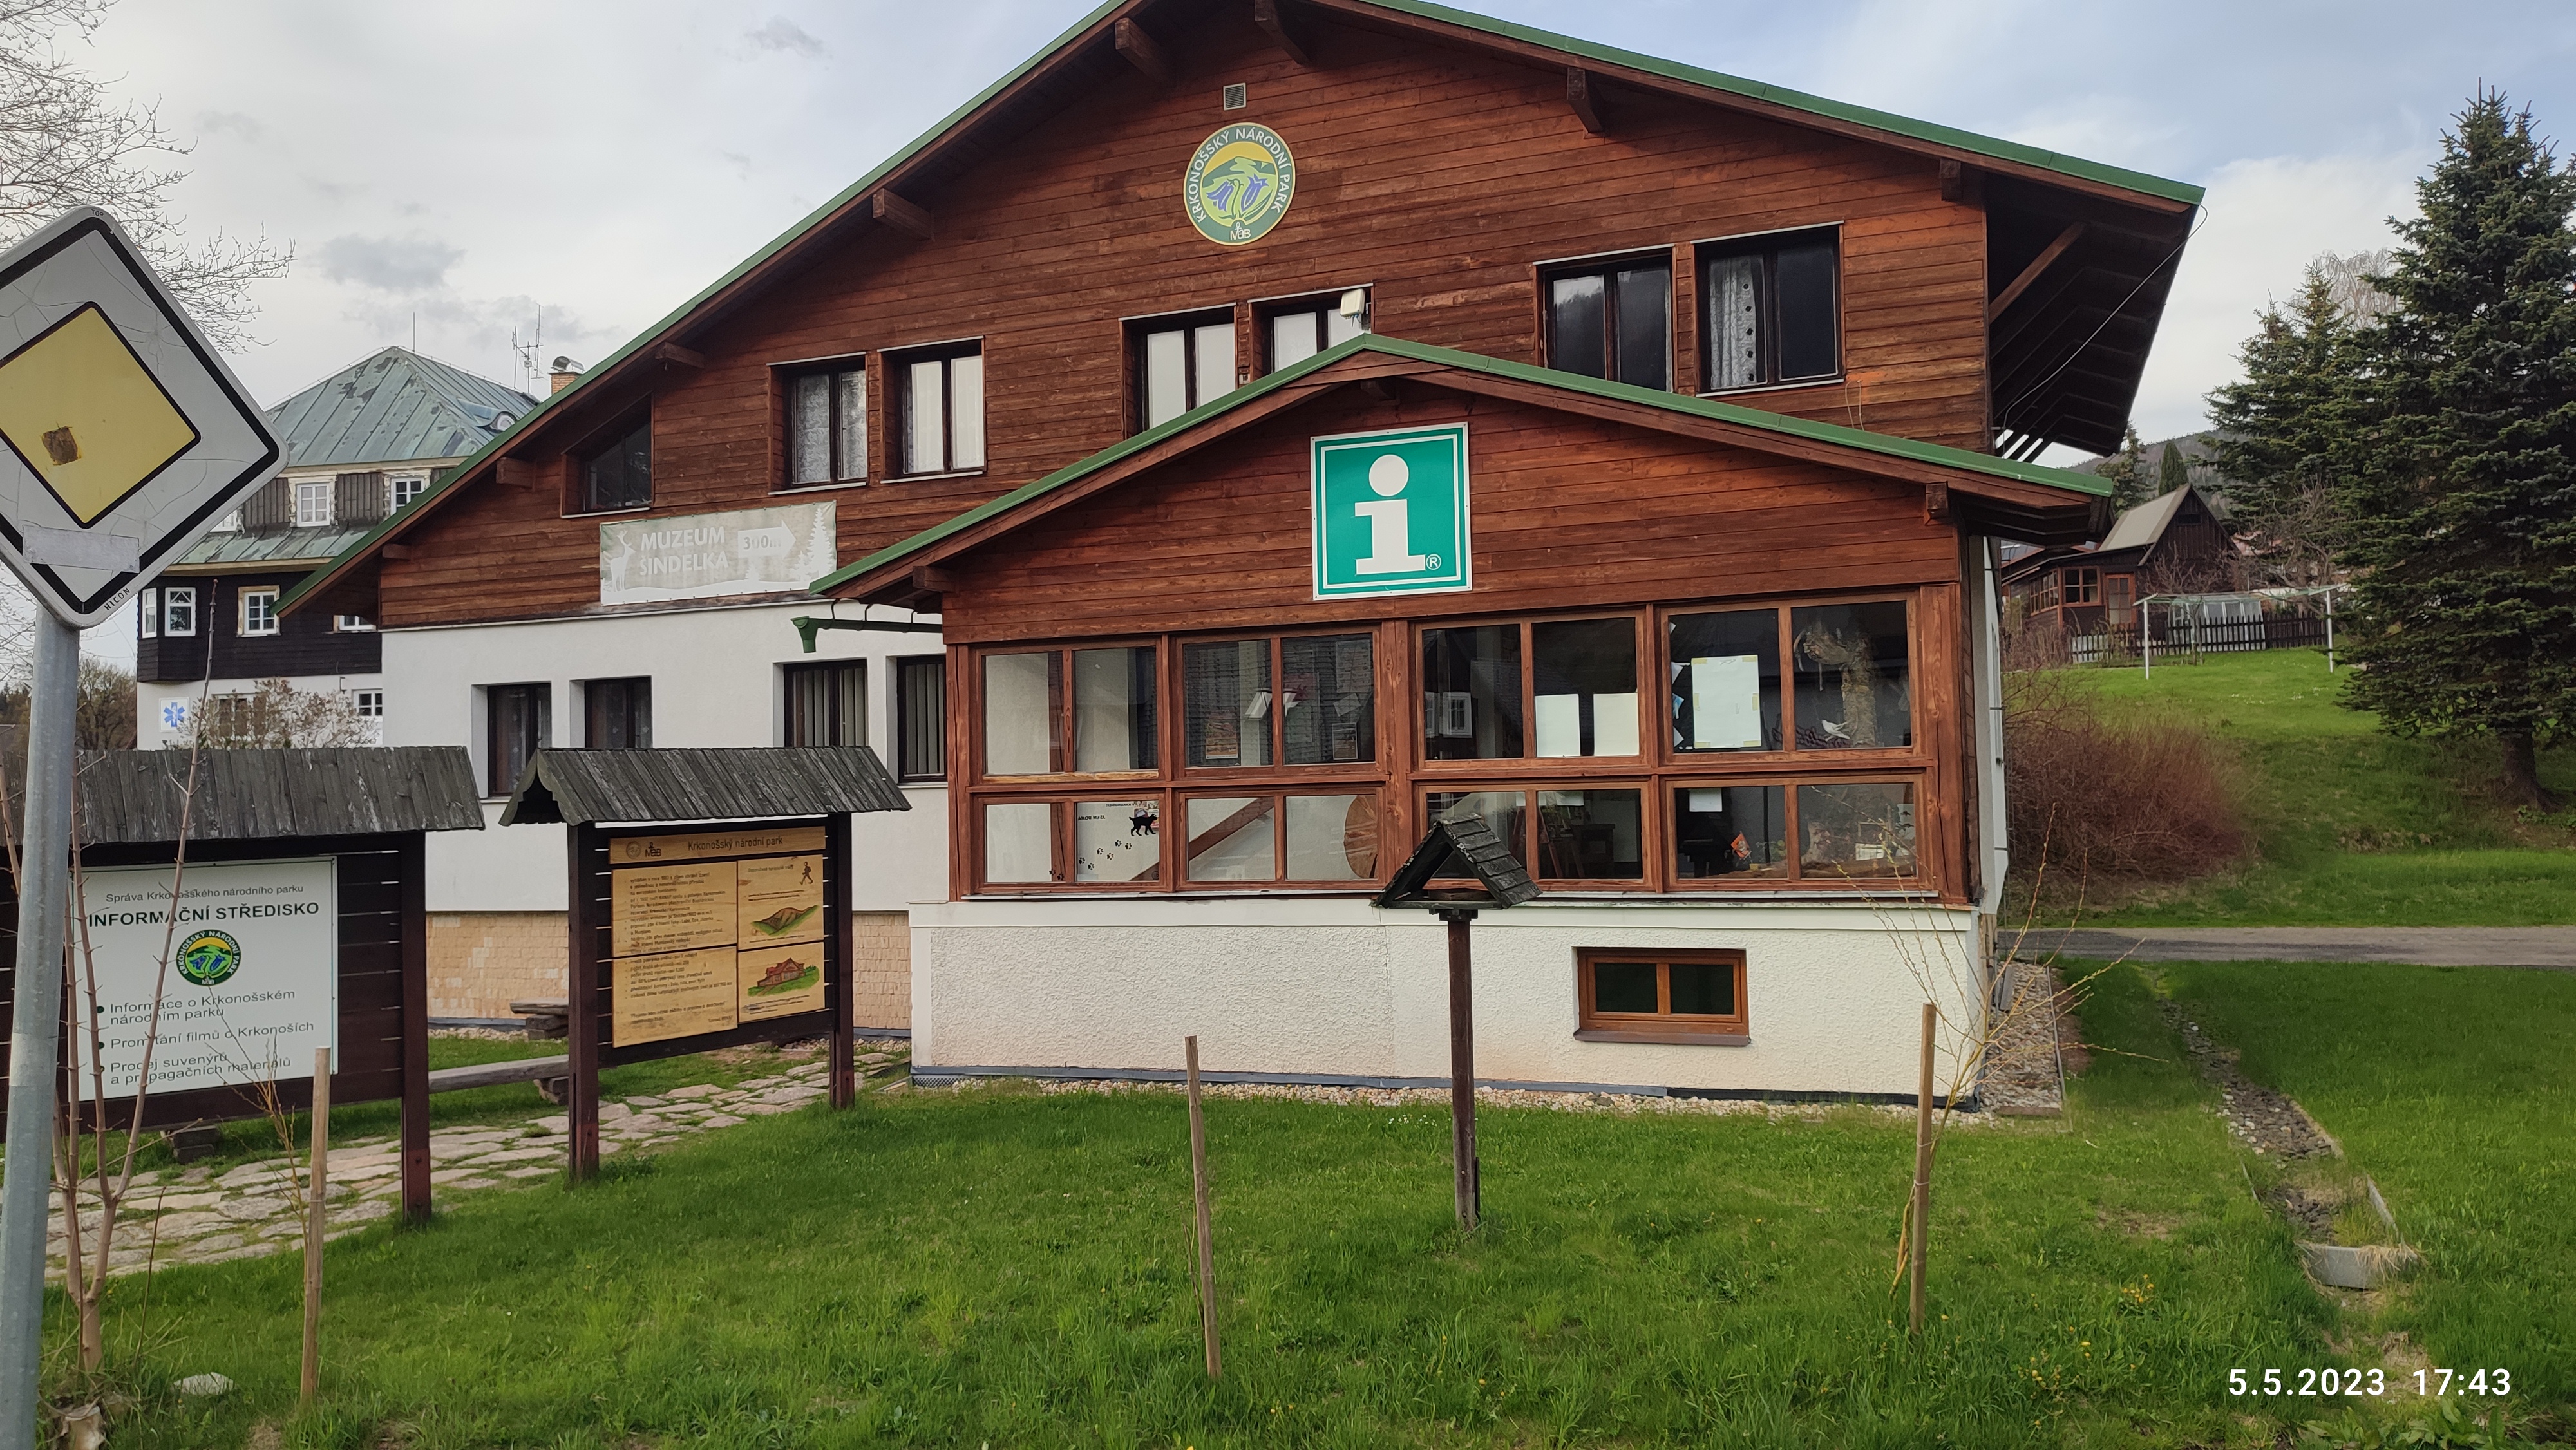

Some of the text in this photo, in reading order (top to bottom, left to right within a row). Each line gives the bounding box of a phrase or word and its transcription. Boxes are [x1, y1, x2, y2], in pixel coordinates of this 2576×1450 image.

[1188, 127, 1291, 223] KRKONOŠSKÝ NÁRODNÍ PARK
[91, 209, 104, 217] TOP
[640, 525, 725, 551] MUZEUM
[639, 551, 729, 576] ŠINDELKA
[688, 839, 733, 851] Krkonošský
[735, 837, 764, 848] národní
[766, 836, 783, 847] park
[106, 885, 304, 905] Správa Krkoošského národního parku
[216, 902, 319, 920] STŘEDISKO
[227, 956, 240, 975] PARK
[202, 991, 295, 1006] Krkonošském
[185, 1008, 224, 1022] parku
[111, 1033, 182, 1049] Promtání
[187, 1030, 220, 1042] filmů
[238, 1022, 314, 1038] Krkonoších
[163, 1052, 227, 1069] suvenýrů
[111, 1076, 120, 1085] a
[125, 1064, 223, 1086] prpagačních
